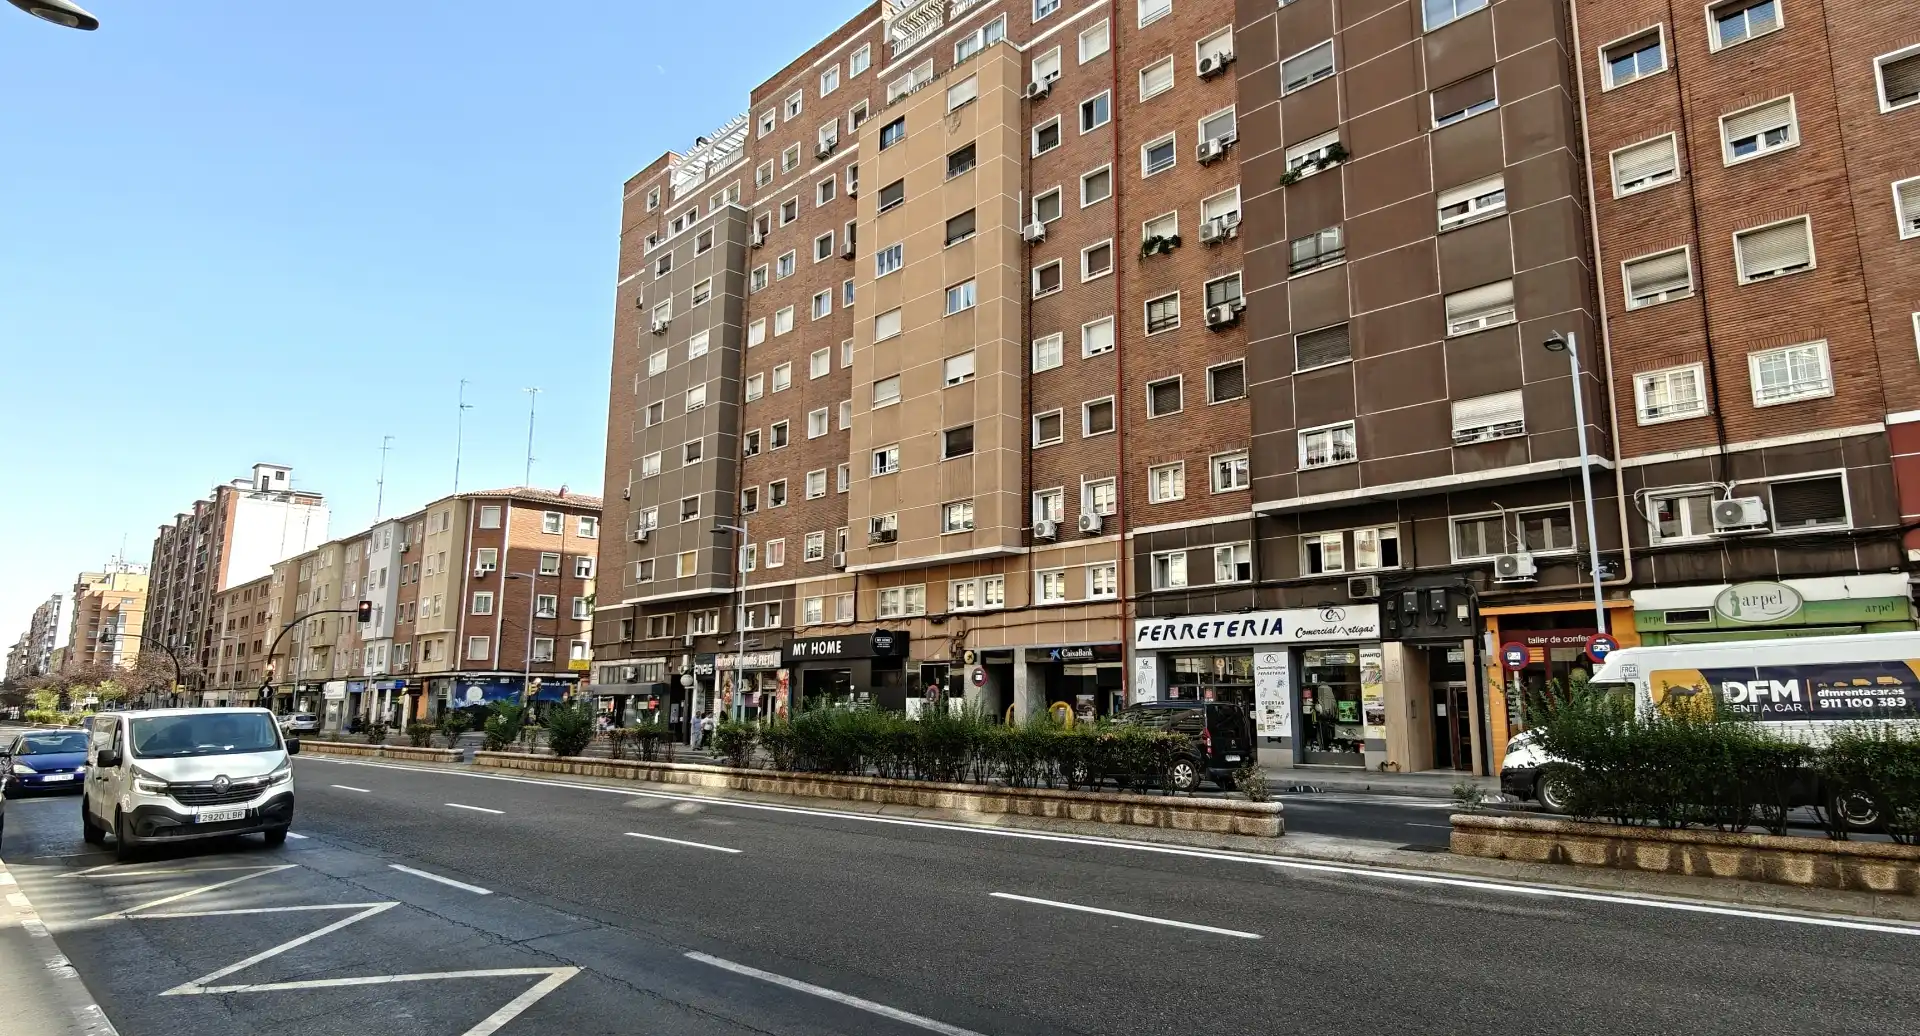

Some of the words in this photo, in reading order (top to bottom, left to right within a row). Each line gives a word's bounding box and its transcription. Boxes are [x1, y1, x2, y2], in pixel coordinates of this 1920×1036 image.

[1742, 590, 1783, 609] arpel
[1865, 601, 1895, 614] arpel
[1643, 616, 1664, 625] arpe
[1137, 618, 1283, 642] FERRETERIA
[1295, 625, 1337, 638] Comercial
[1337, 625, 1374, 636] Artigas
[1527, 636, 1548, 644] taller
[1550, 635, 1561, 643] de
[792, 643, 807, 656] MY
[811, 641, 842, 655] HOME
[1061, 648, 1093, 657] CaixaBank
[1722, 679, 1800, 704] DFM
[1817, 688, 1905, 698] dfmrentacar.es
[1762, 704, 1772, 713] A
[1775, 703, 1803, 712] CAR
[1819, 698, 1842, 709] 911
[1845, 697, 1874, 708] 100
[1877, 696, 1907, 707] 389
[202, 813, 224, 822] 2920
